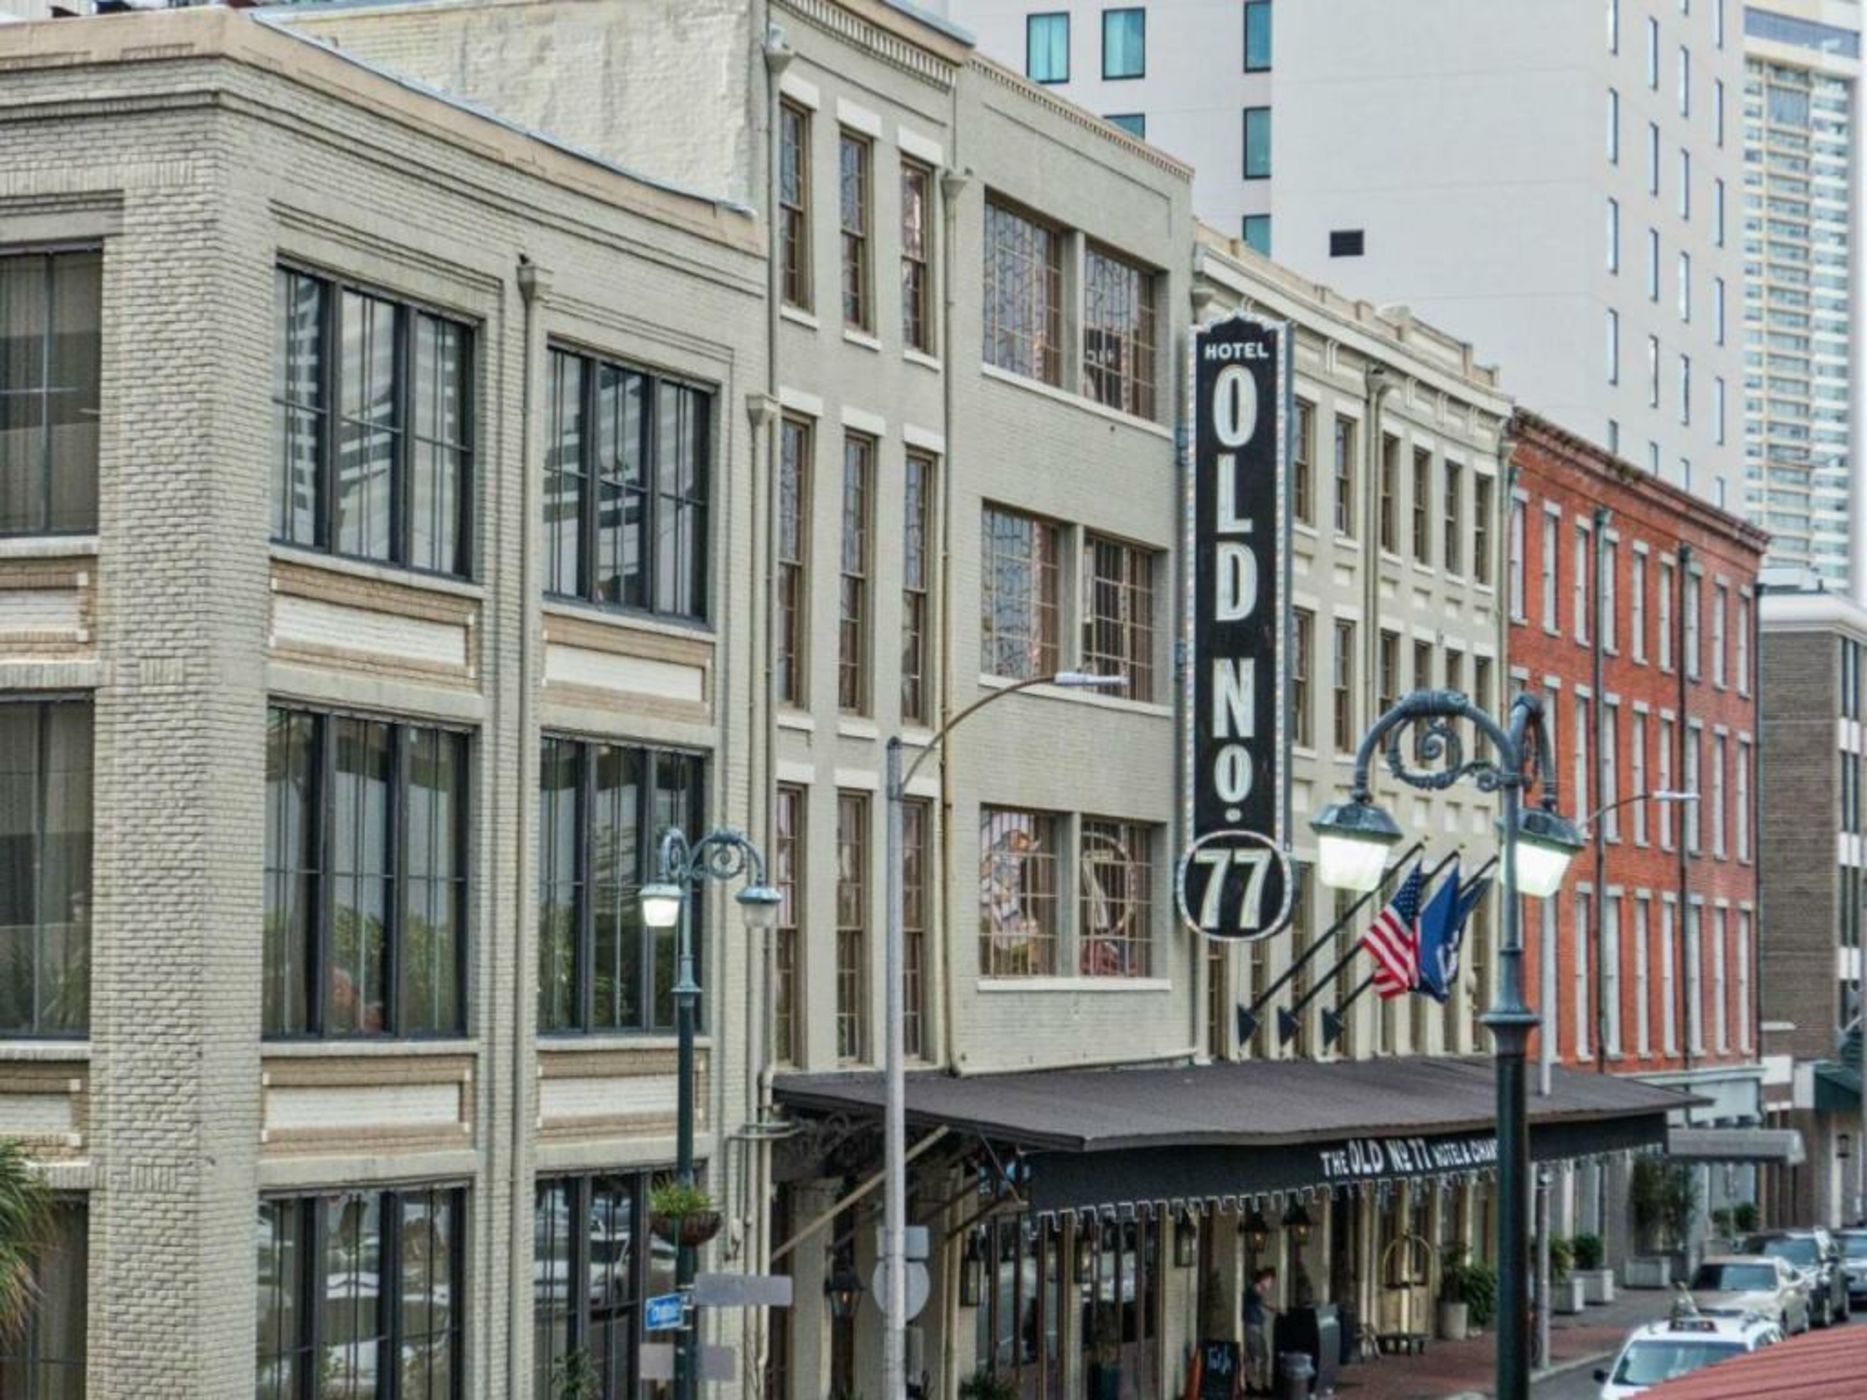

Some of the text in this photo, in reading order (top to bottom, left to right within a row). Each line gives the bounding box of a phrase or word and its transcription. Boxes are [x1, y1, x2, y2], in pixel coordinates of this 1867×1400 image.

[1204, 342, 1269, 360] HOTEL
[1213, 364, 1258, 621] OLD
[1194, 847, 1272, 929] 77
[1320, 1150, 1350, 1177] THE
[1348, 1138, 1385, 1174] OLD
[1408, 1137, 1432, 1169] 77
